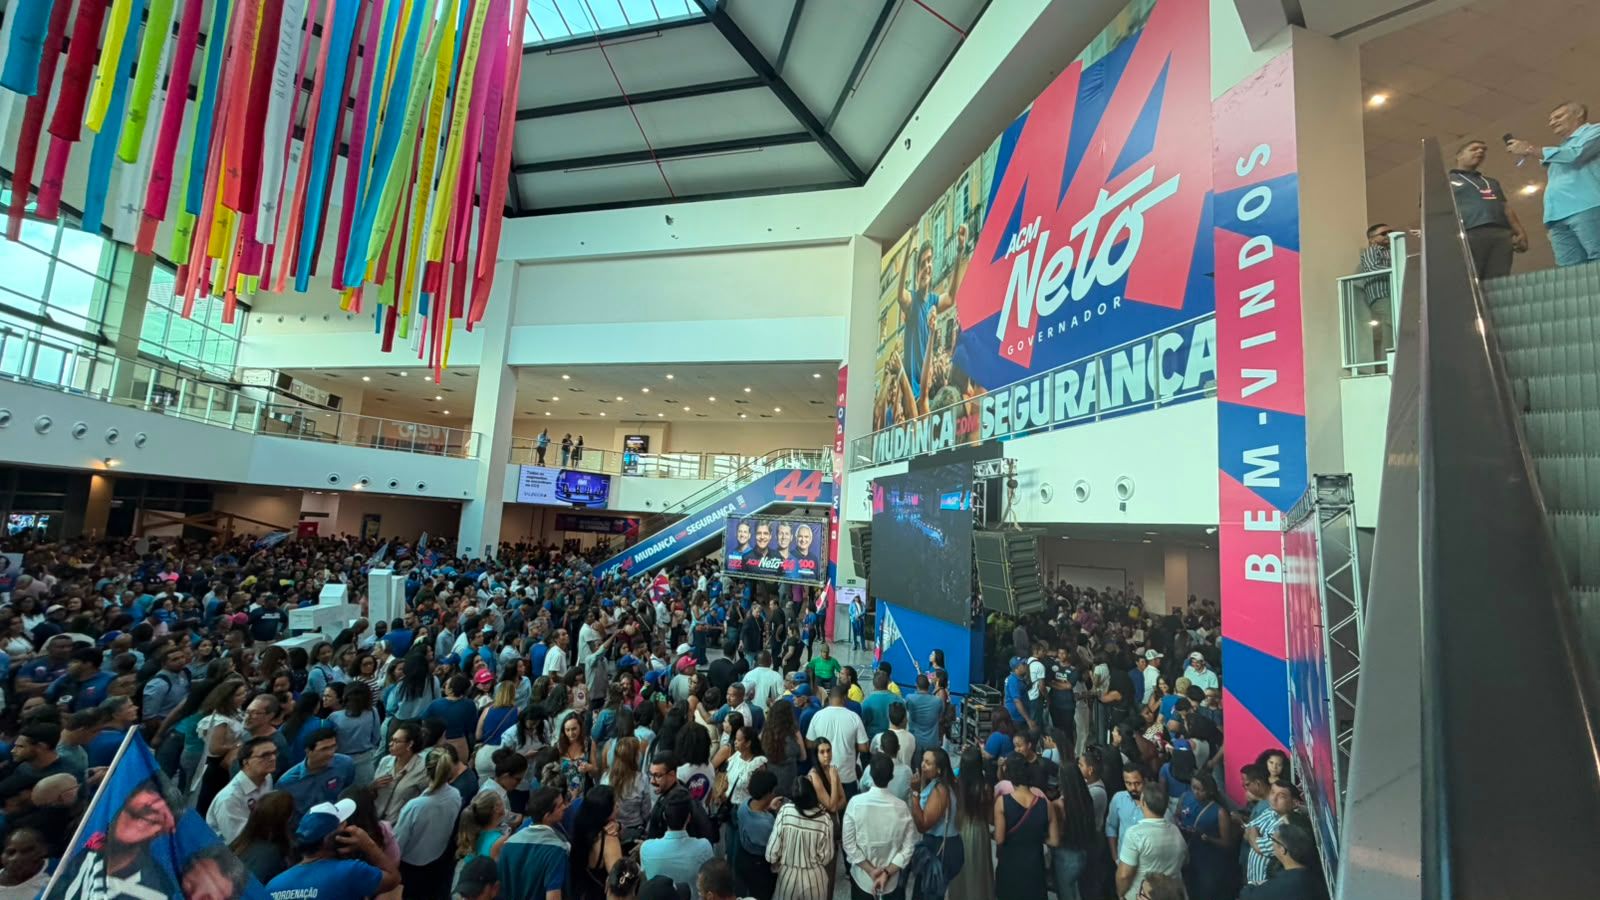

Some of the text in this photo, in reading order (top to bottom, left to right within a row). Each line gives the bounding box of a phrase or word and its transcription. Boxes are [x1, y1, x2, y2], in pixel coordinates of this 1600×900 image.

[956, 0, 1209, 312] 44
[996, 165, 1181, 341] Neto
[1005, 216, 1041, 260] ACM
[1007, 296, 1121, 356] GOVERNADOR
[873, 318, 1217, 462] MUDANÇA COM SEGURANÇA
[1235, 142, 1283, 583] BEM-VINDOS
[774, 470, 824, 503] 44
[634, 535, 677, 564] MUDANÇA
[686, 503, 737, 536] SEGURANÇA
[758, 556, 783, 569] Neto
